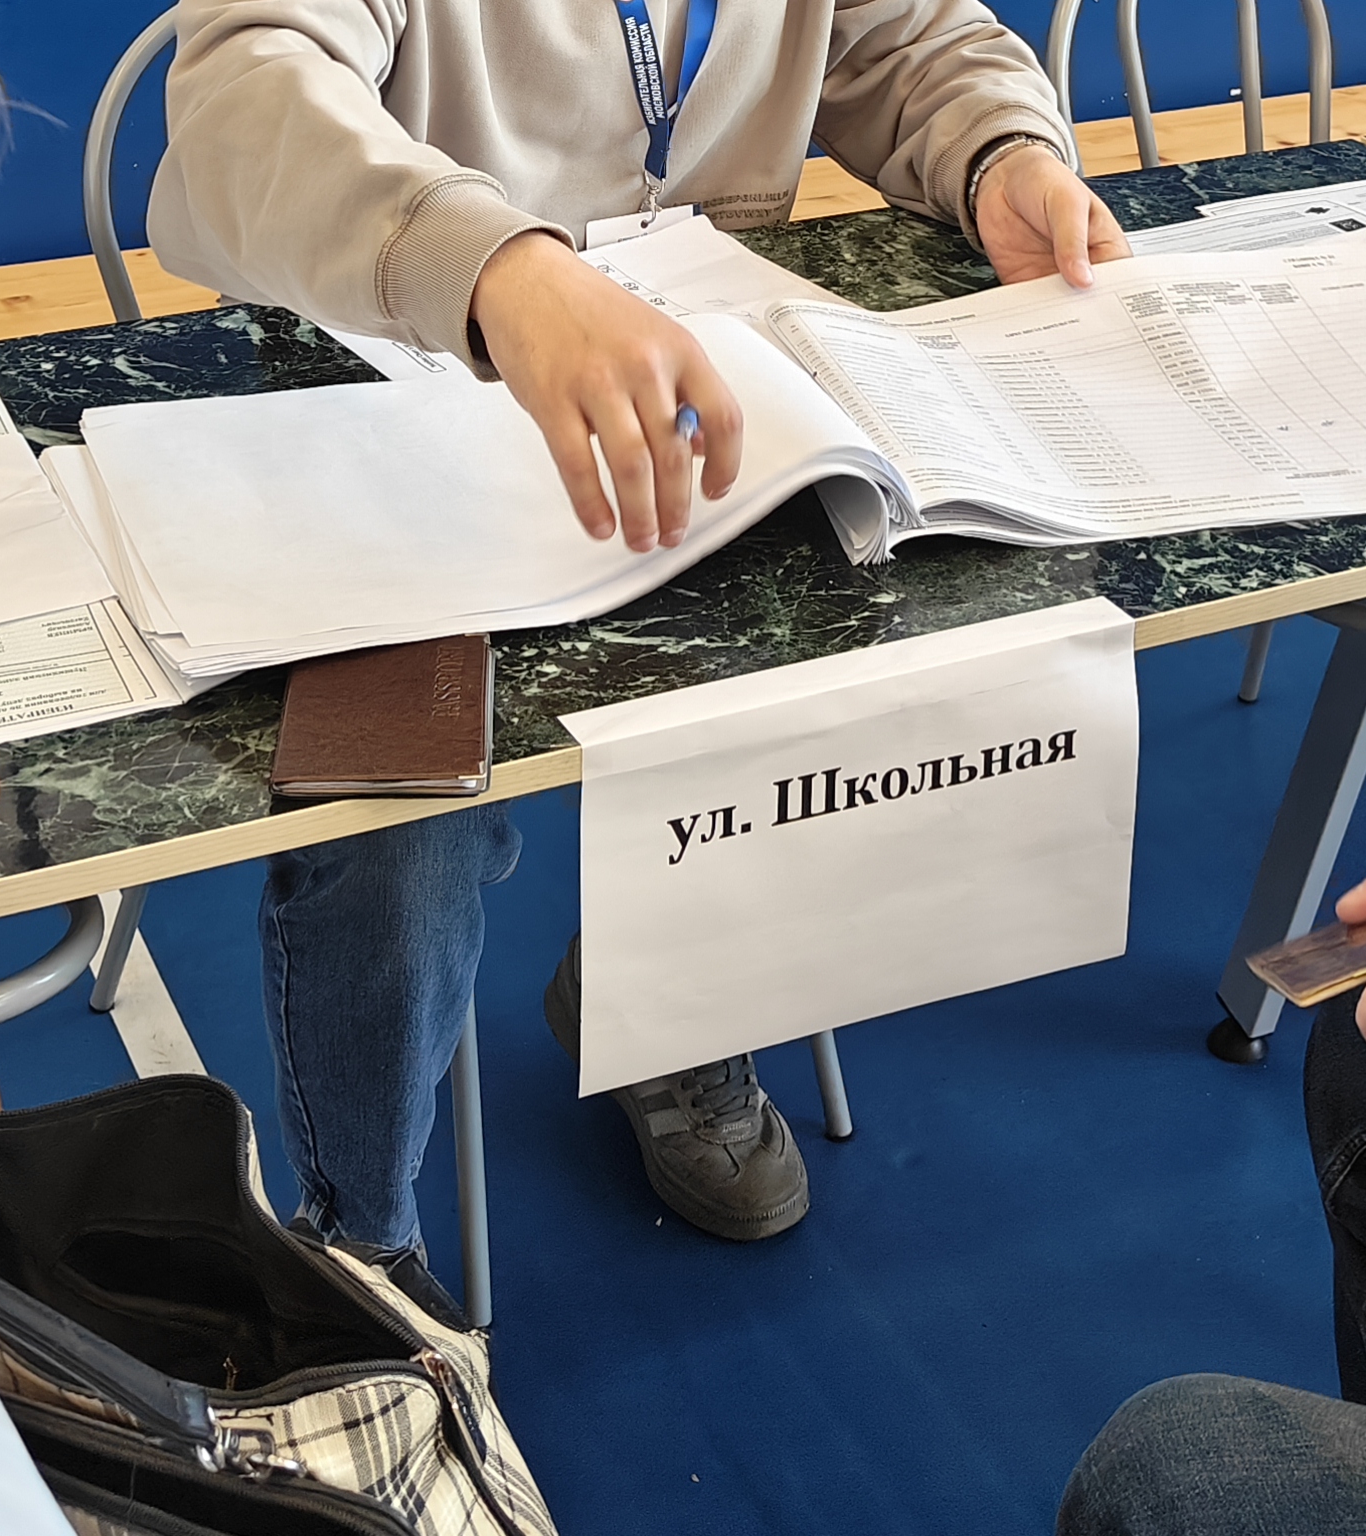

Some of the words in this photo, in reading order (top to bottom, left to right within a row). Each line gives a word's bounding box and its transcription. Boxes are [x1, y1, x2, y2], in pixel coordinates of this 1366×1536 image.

[625, 16, 644, 64] КОМИССИЯ
[638, 22, 656, 64] ОБЛАСТИ
[635, 64, 657, 126] ИЗБИРАТЕЛЬНАЯ
[645, 63, 666, 119] МОСКОВСКОЙ
[666, 805, 752, 866] ул.
[771, 728, 1077, 827] Школьная
